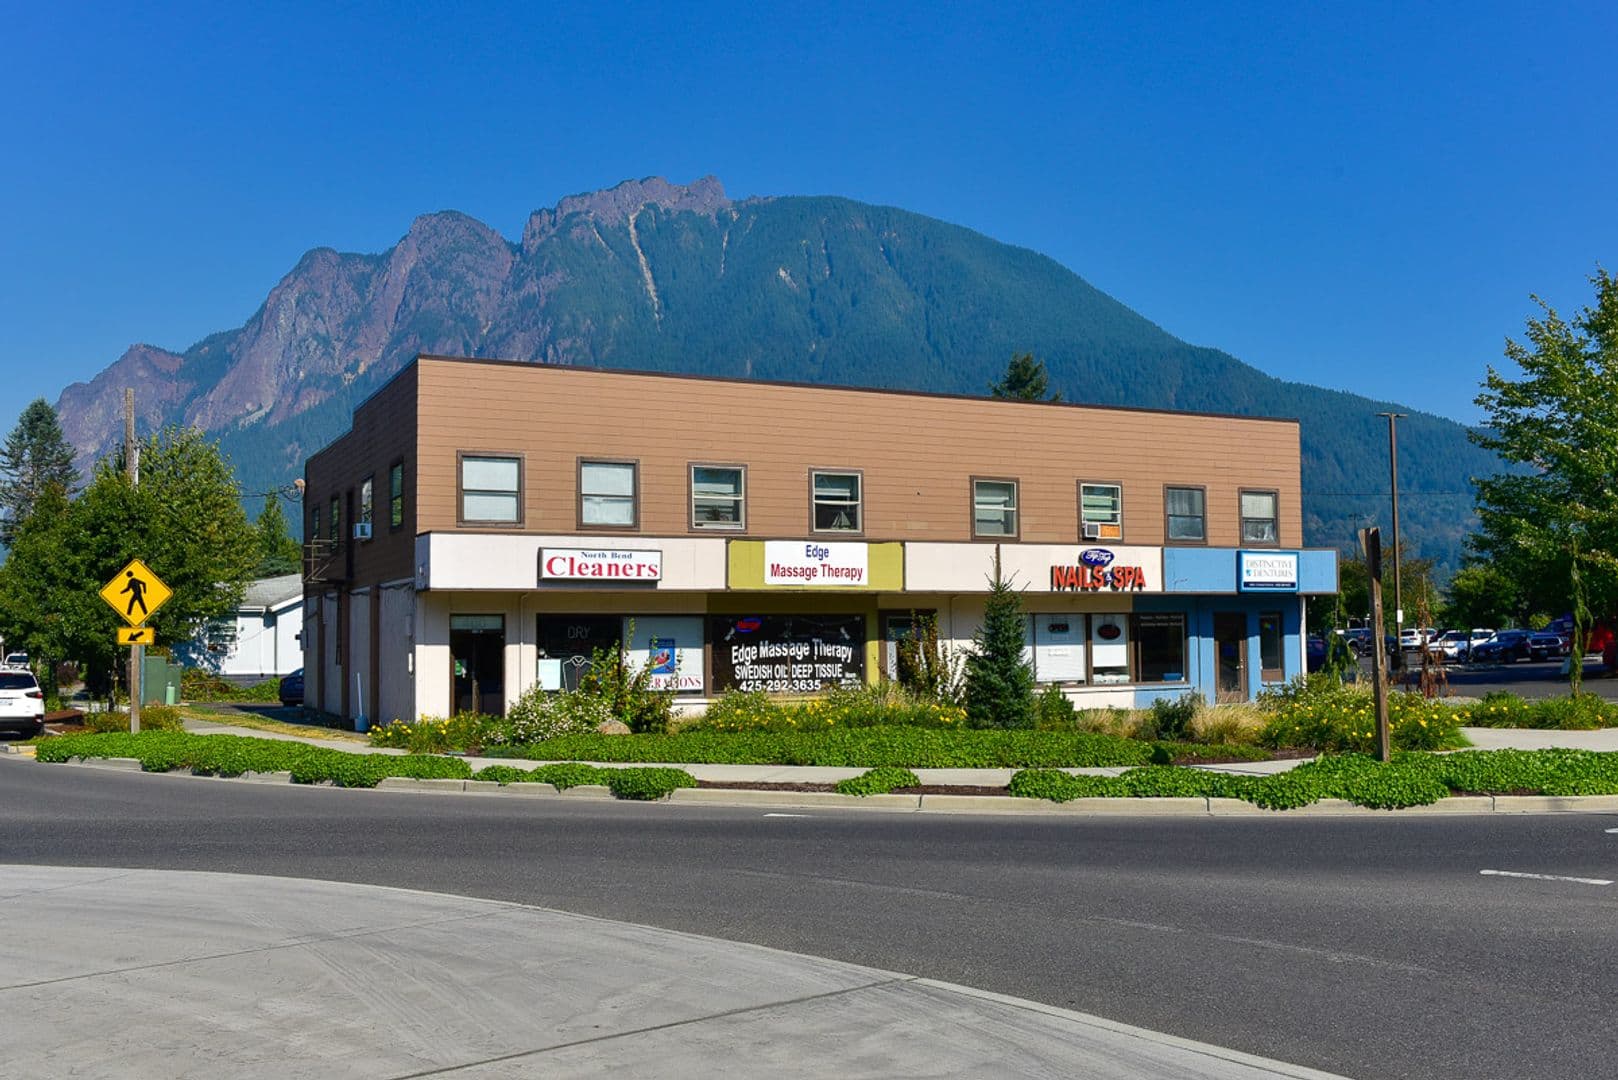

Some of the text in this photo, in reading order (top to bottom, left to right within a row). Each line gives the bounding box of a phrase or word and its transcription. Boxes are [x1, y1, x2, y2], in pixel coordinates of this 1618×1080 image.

[581, 551, 632, 560] North Bend
[805, 544, 829, 561] Edge
[546, 555, 658, 577] Cleaners
[771, 563, 863, 582] Massage Therapy
[1245, 559, 1293, 569] DISTINCTIVE
[1253, 568, 1293, 577] DENTURES
[1053, 565, 1104, 588] NAILS
[1113, 566, 1146, 588] SPA
[567, 625, 591, 639] DRY
[731, 638, 853, 666] Edge Massage Therapy
[734, 665, 773, 680] SWEDISH
[791, 664, 813, 679] DEEP
[814, 663, 843, 678] TISSUE
